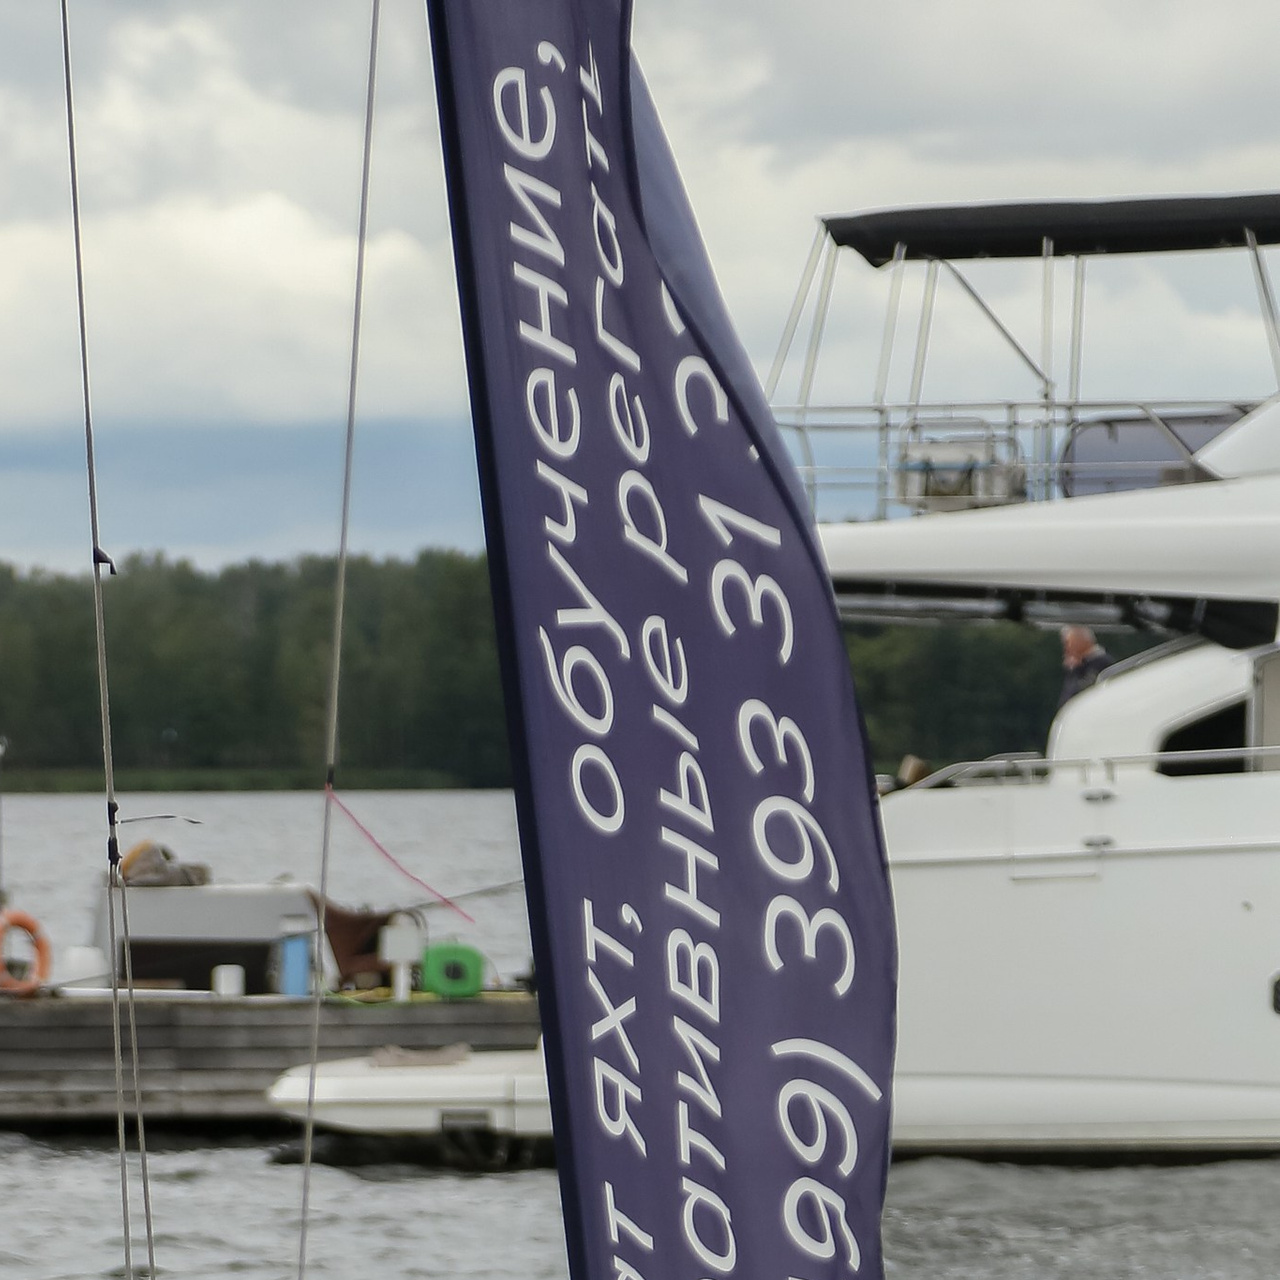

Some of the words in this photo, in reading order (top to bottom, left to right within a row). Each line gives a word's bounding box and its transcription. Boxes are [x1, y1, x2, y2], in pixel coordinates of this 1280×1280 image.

[493, 40, 626, 834] обучение,
[697, 492, 795, 665] 31
[738, 698, 857, 998] 393
[582, 896, 648, 1159] яхт,
